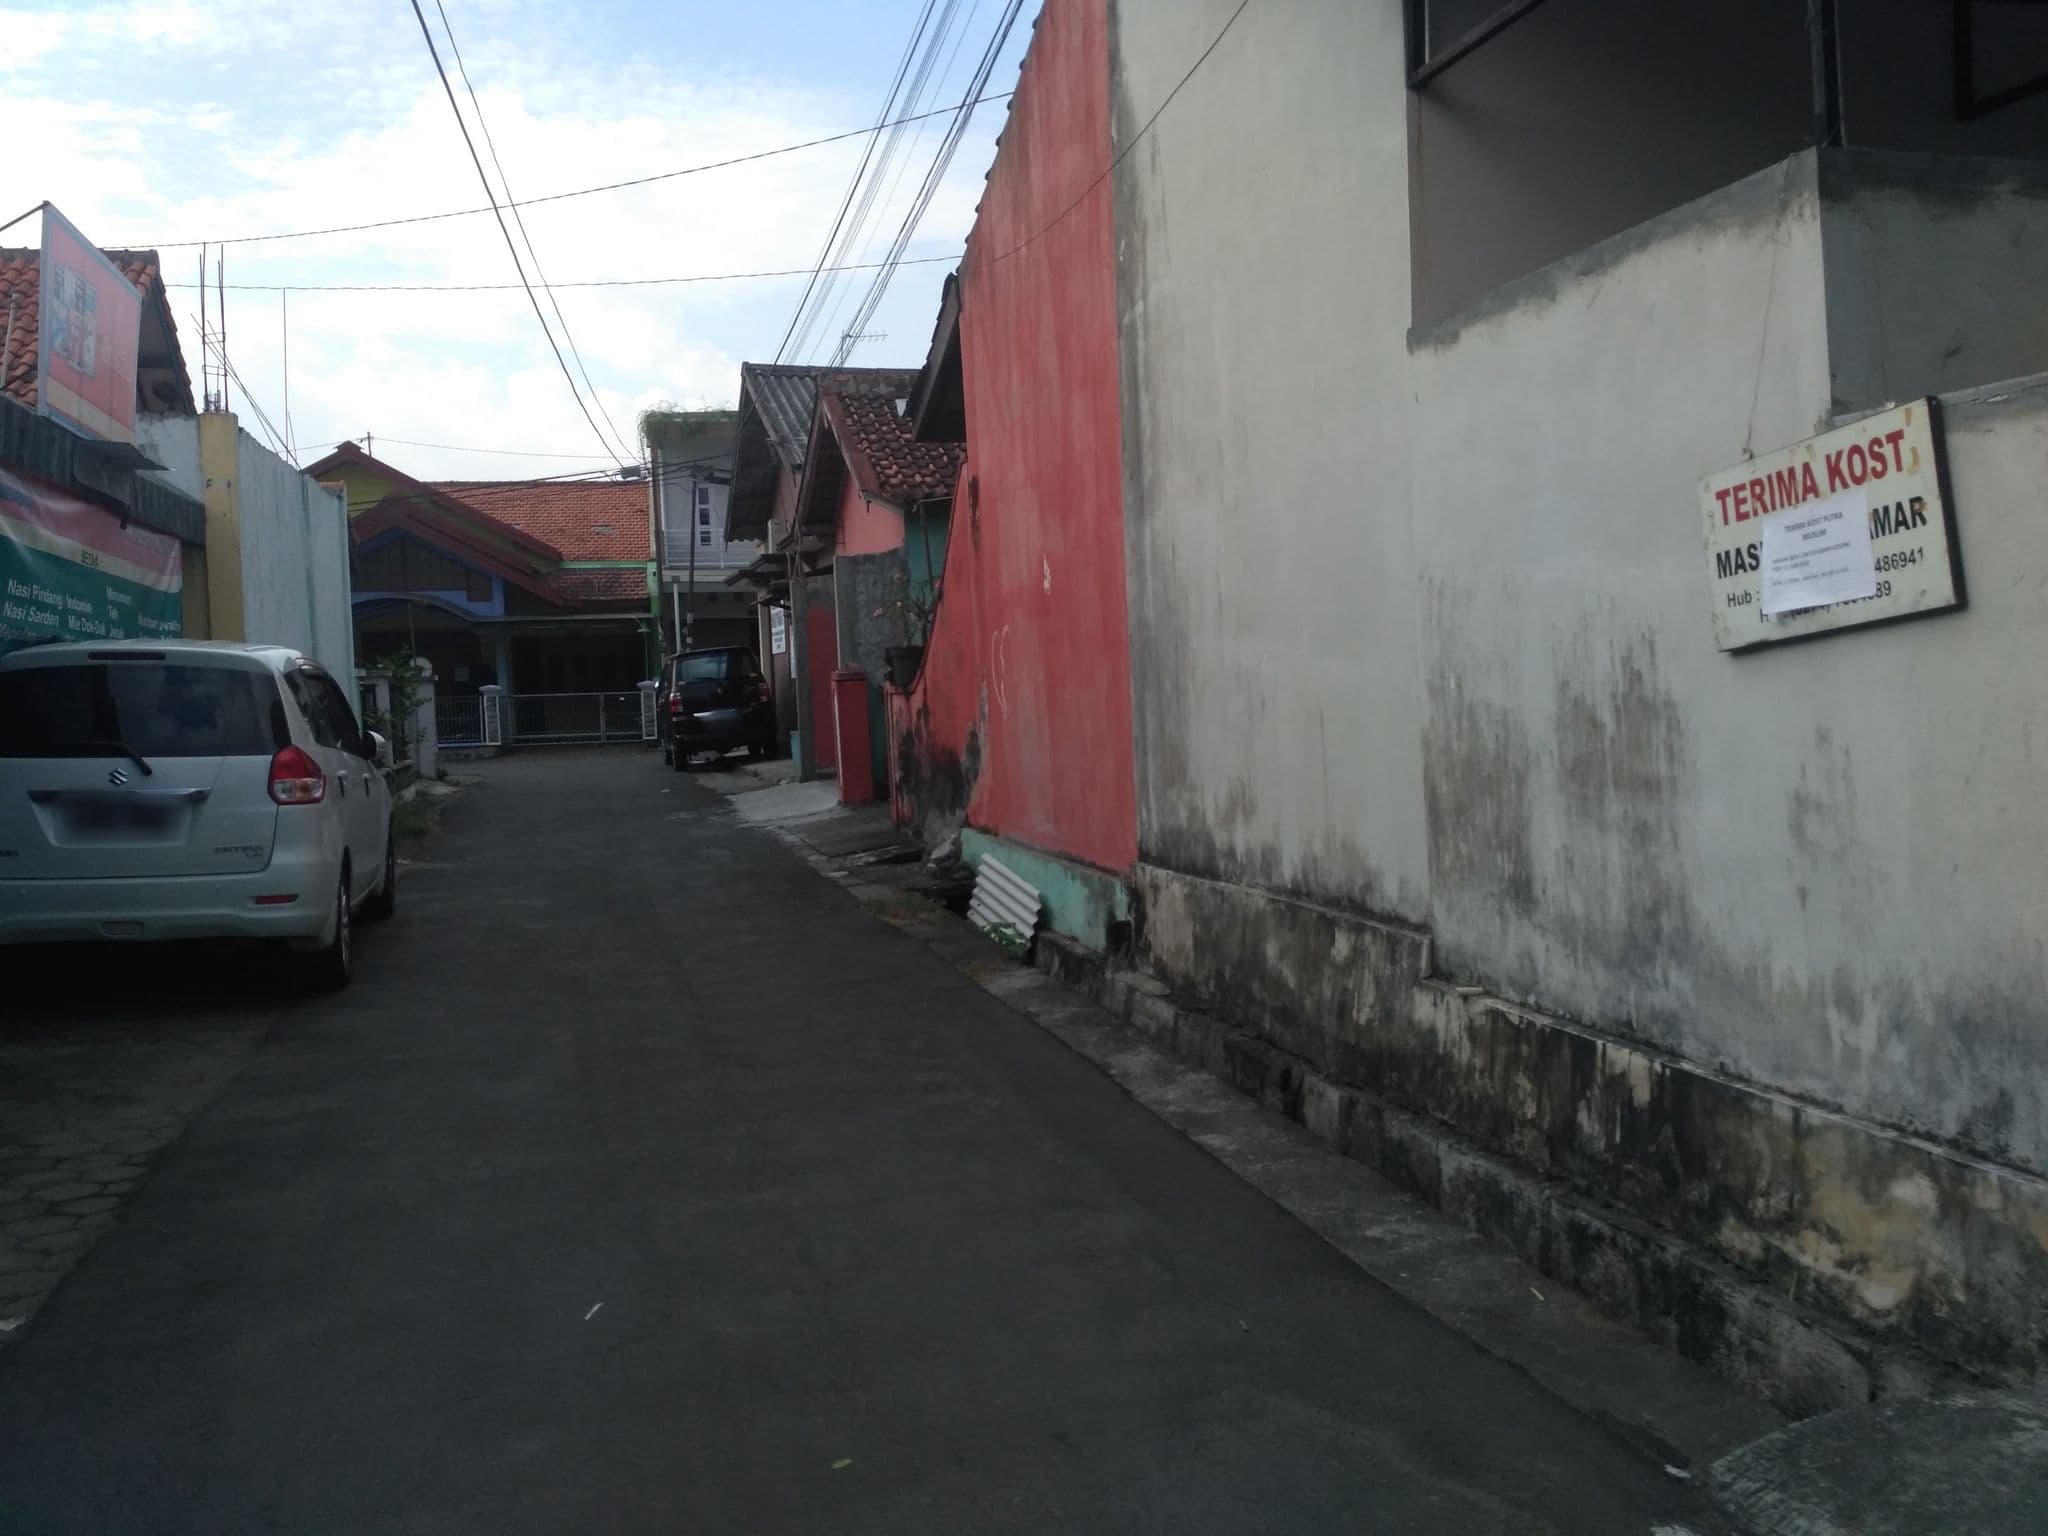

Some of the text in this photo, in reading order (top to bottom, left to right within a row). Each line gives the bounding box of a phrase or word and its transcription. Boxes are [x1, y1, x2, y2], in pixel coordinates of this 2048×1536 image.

[1715, 428, 1905, 526] TERIMA KOST
[1869, 496, 1928, 540] MAR
[8, 578, 63, 610] Nasi Pindang
[1727, 589, 1753, 608] Hub
[3, 601, 60, 626] Nasi Sarden
